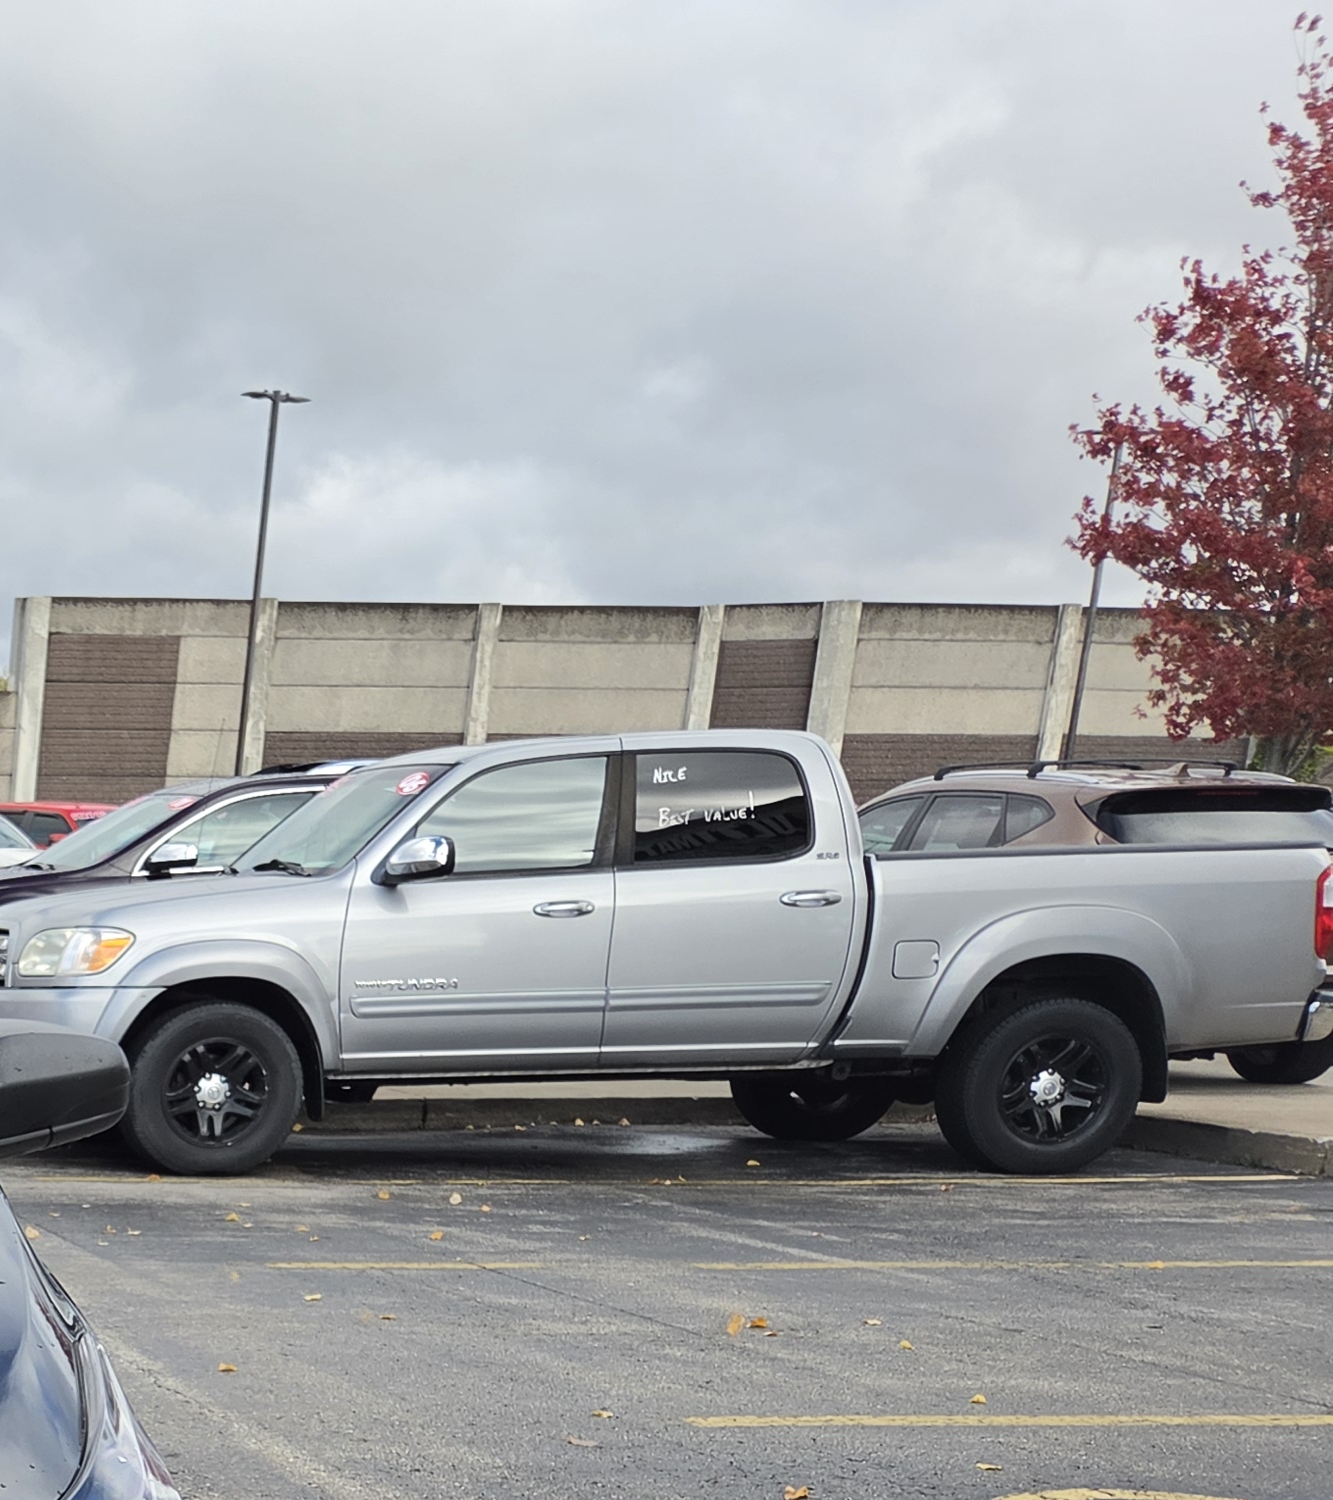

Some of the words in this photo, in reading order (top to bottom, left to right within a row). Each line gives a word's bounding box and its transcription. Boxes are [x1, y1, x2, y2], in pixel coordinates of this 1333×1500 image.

[653, 766, 688, 784] NICE
[704, 790, 756, 823] VALUE!
[388, 977, 459, 991] TUNDRA
